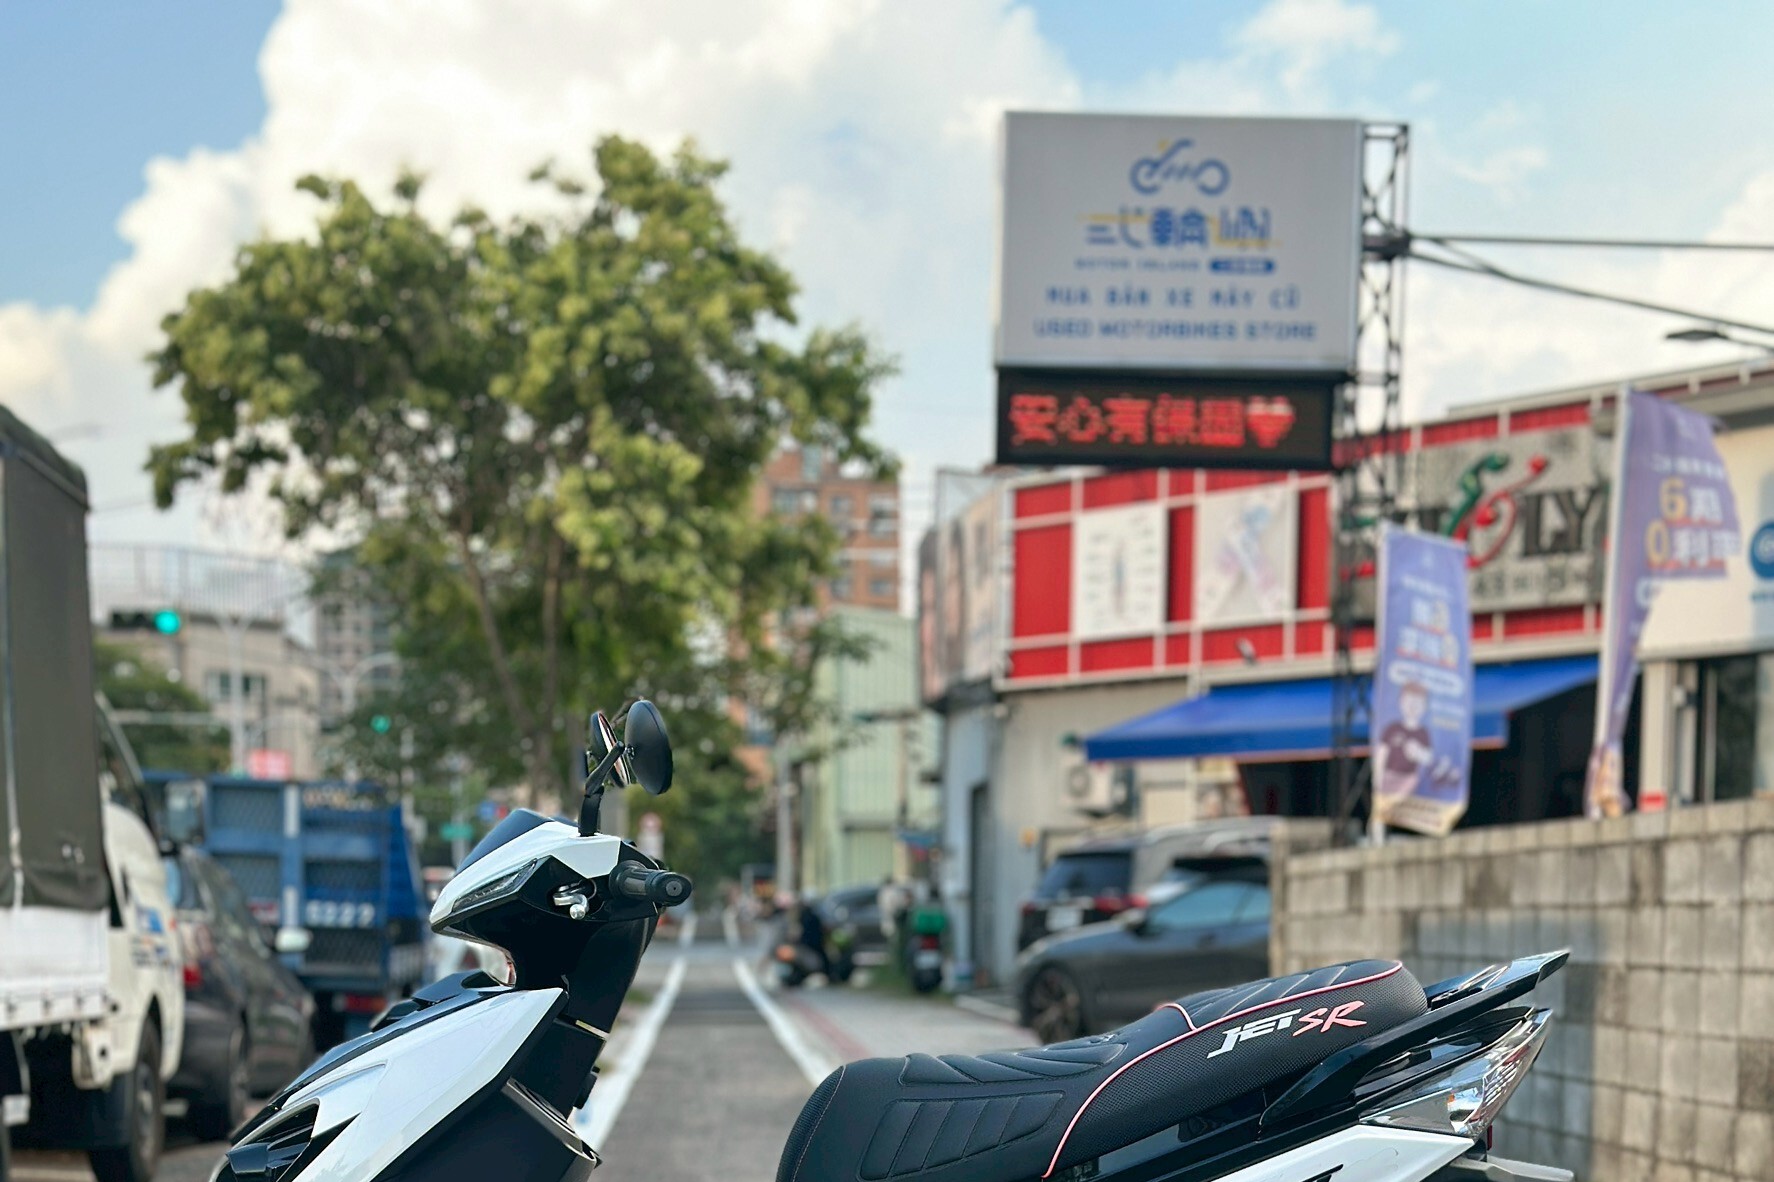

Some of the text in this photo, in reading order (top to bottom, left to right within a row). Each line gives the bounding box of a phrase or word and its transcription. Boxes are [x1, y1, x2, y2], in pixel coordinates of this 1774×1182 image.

[1034, 317, 1317, 341] USED MOTORBIKES STORE
[1207, 1001, 1367, 1059] JET SR
